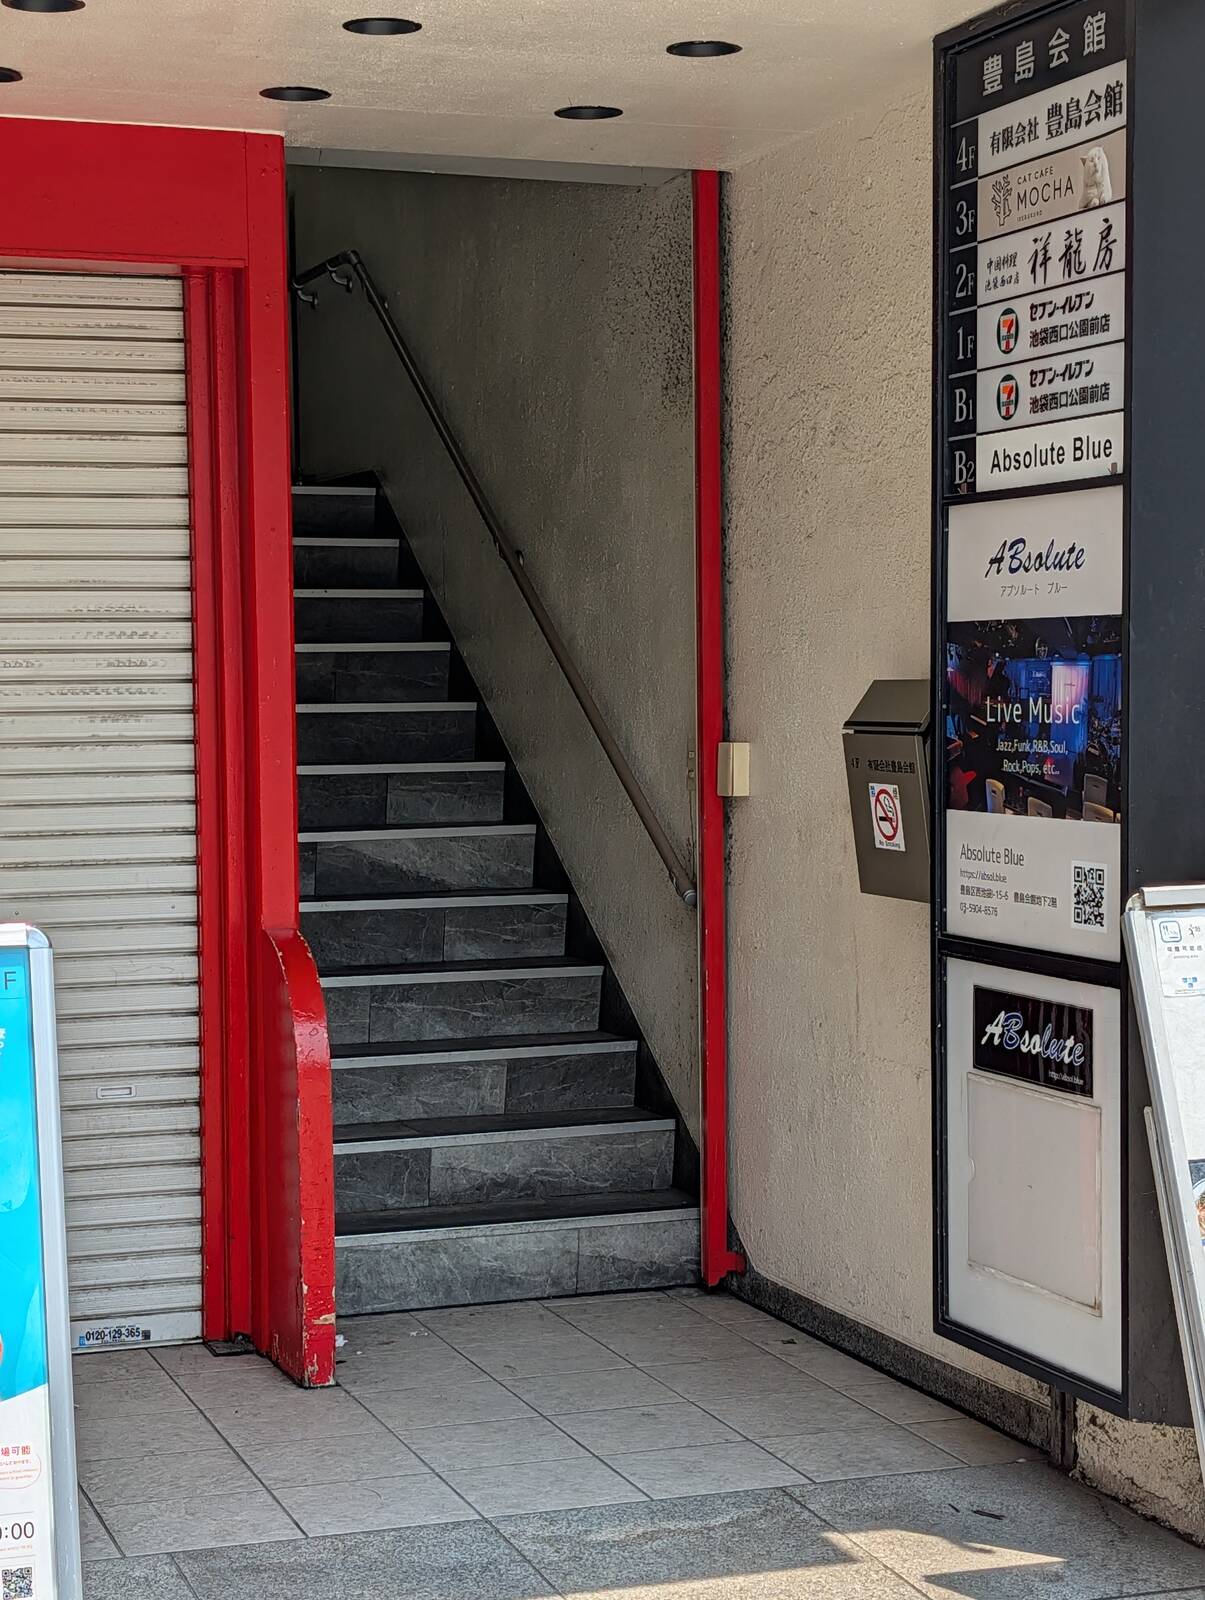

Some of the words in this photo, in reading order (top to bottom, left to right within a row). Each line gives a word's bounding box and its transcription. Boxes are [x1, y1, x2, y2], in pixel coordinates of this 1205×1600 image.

[983, 11, 1106, 96] 豊島会館
[990, 116, 1039, 156] 有限会社
[956, 137, 976, 172] 4F
[1017, 173, 1032, 185] CAT
[1034, 165, 1053, 180] CAFE
[1016, 176, 1074, 212] MOCHA
[956, 201, 976, 235] 3F
[955, 264, 975, 298] 2F
[957, 326, 975, 360] 1F
[1029, 313, 1110, 348] 池袋西口公園前店
[955, 388, 973, 423] B1
[1029, 382, 1110, 414] 池袋西口公園前店
[955, 451, 975, 485] B2
[990, 442, 1065, 474] Absolute
[1072, 436, 1112, 462] Blue
[984, 537, 1086, 578] ABsolute
[985, 696, 1022, 723] Live
[1029, 696, 1080, 724] Music
[960, 843, 1001, 864] Absolute
[1004, 848, 1025, 866] Blue
[4, 971, 17, 990] F
[981, 1010, 1085, 1066] ABsolute
[86, 1327, 141, 1341] 0120-129-365
[0, 1521, 35, 1540] :00
